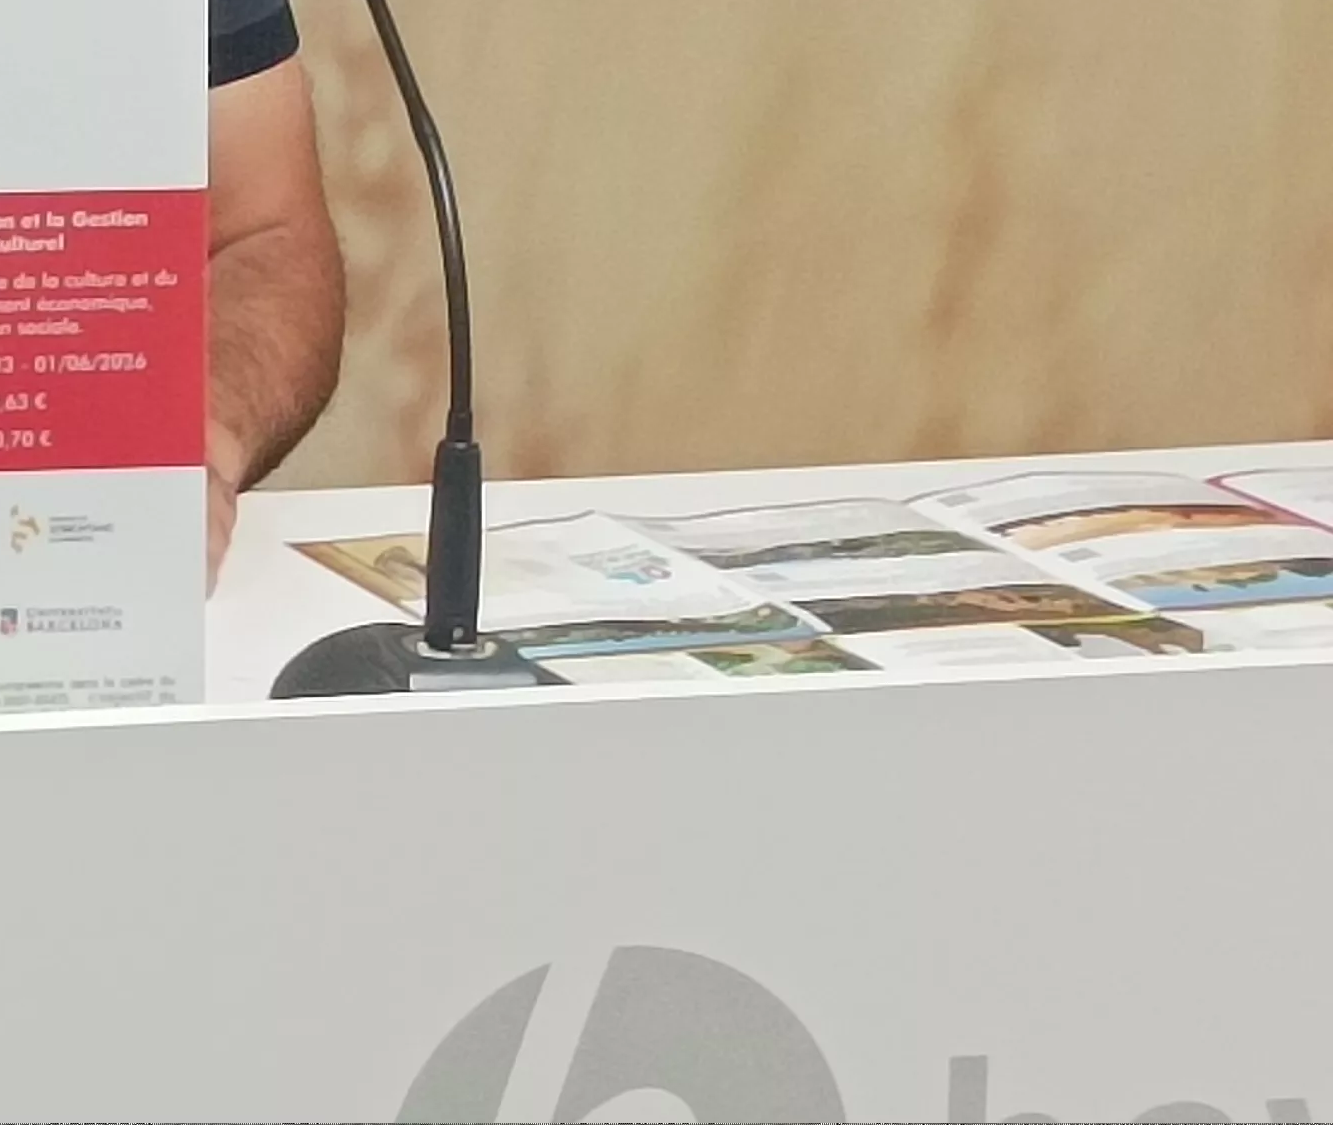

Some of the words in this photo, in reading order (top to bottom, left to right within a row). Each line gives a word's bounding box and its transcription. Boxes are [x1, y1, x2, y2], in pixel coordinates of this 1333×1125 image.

[21, 214, 40, 228] et
[46, 212, 64, 227] la
[72, 210, 148, 227] Gestion
[13, 273, 36, 289] de
[42, 273, 59, 288] la
[63, 271, 126, 288] culture
[131, 272, 148, 286] et
[154, 269, 177, 286] du
[35, 393, 46, 409] €
[39, 430, 51, 446] €
